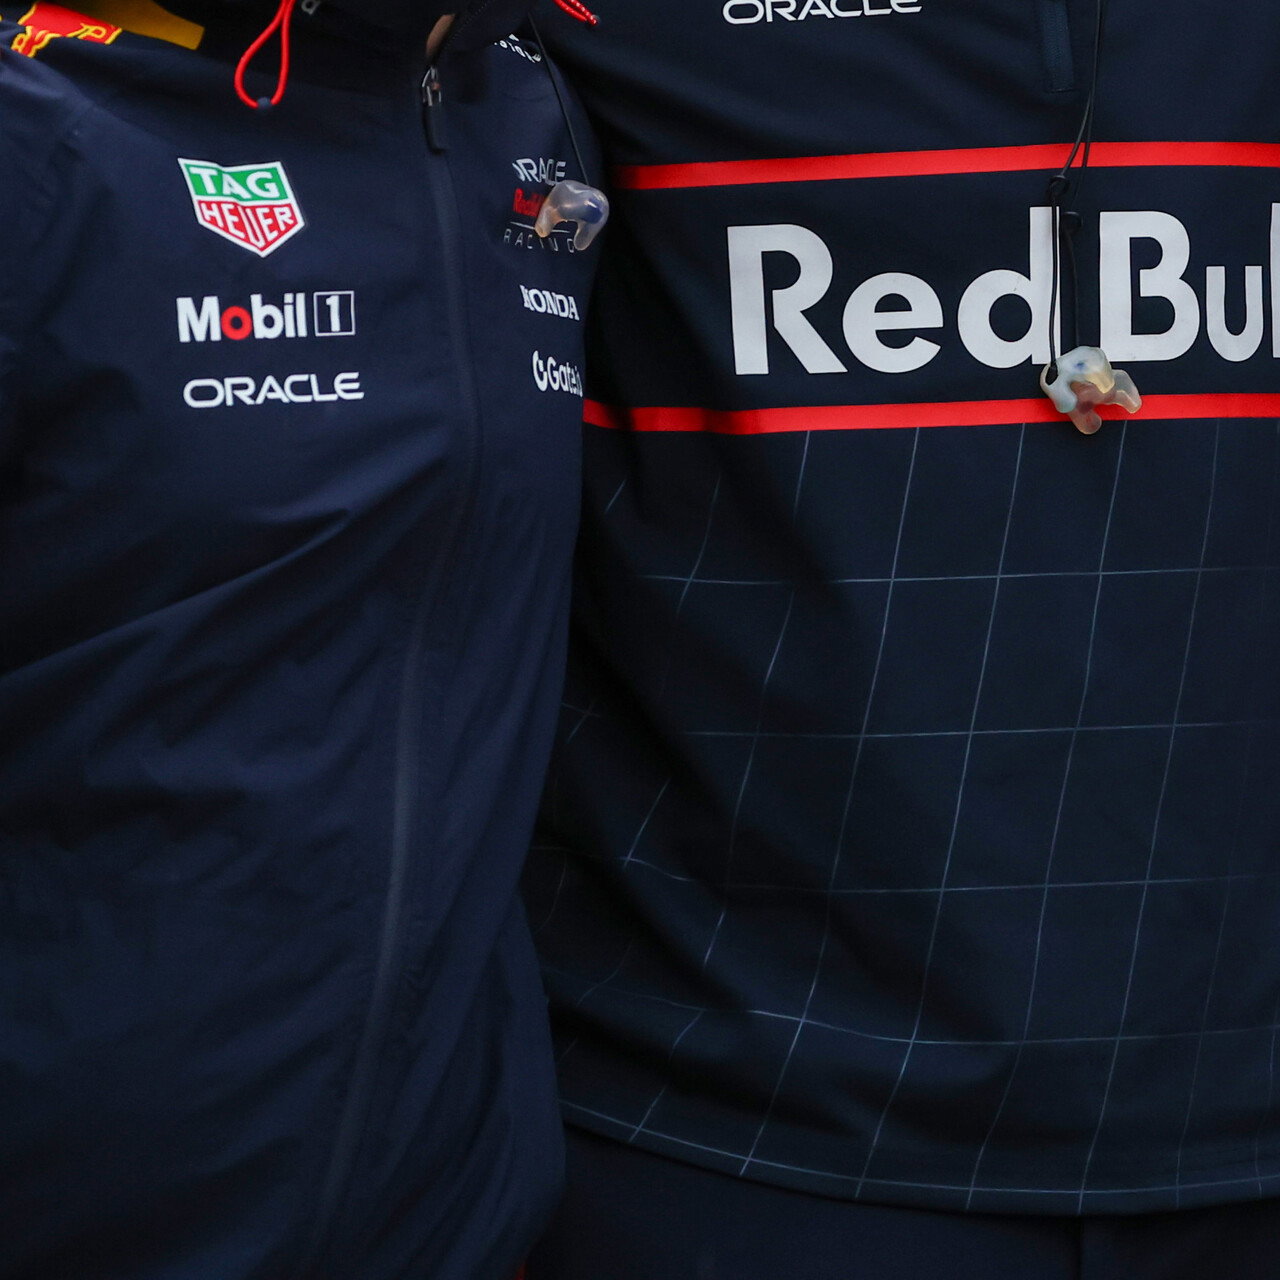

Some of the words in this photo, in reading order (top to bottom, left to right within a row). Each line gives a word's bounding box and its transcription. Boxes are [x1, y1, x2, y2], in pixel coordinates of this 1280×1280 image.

[189, 166, 280, 200] TAG
[200, 202, 294, 248] HEUER
[726, 206, 1063, 376] Red
[176, 292, 308, 343] Mobil
[183, 372, 365, 408] ORACLE
